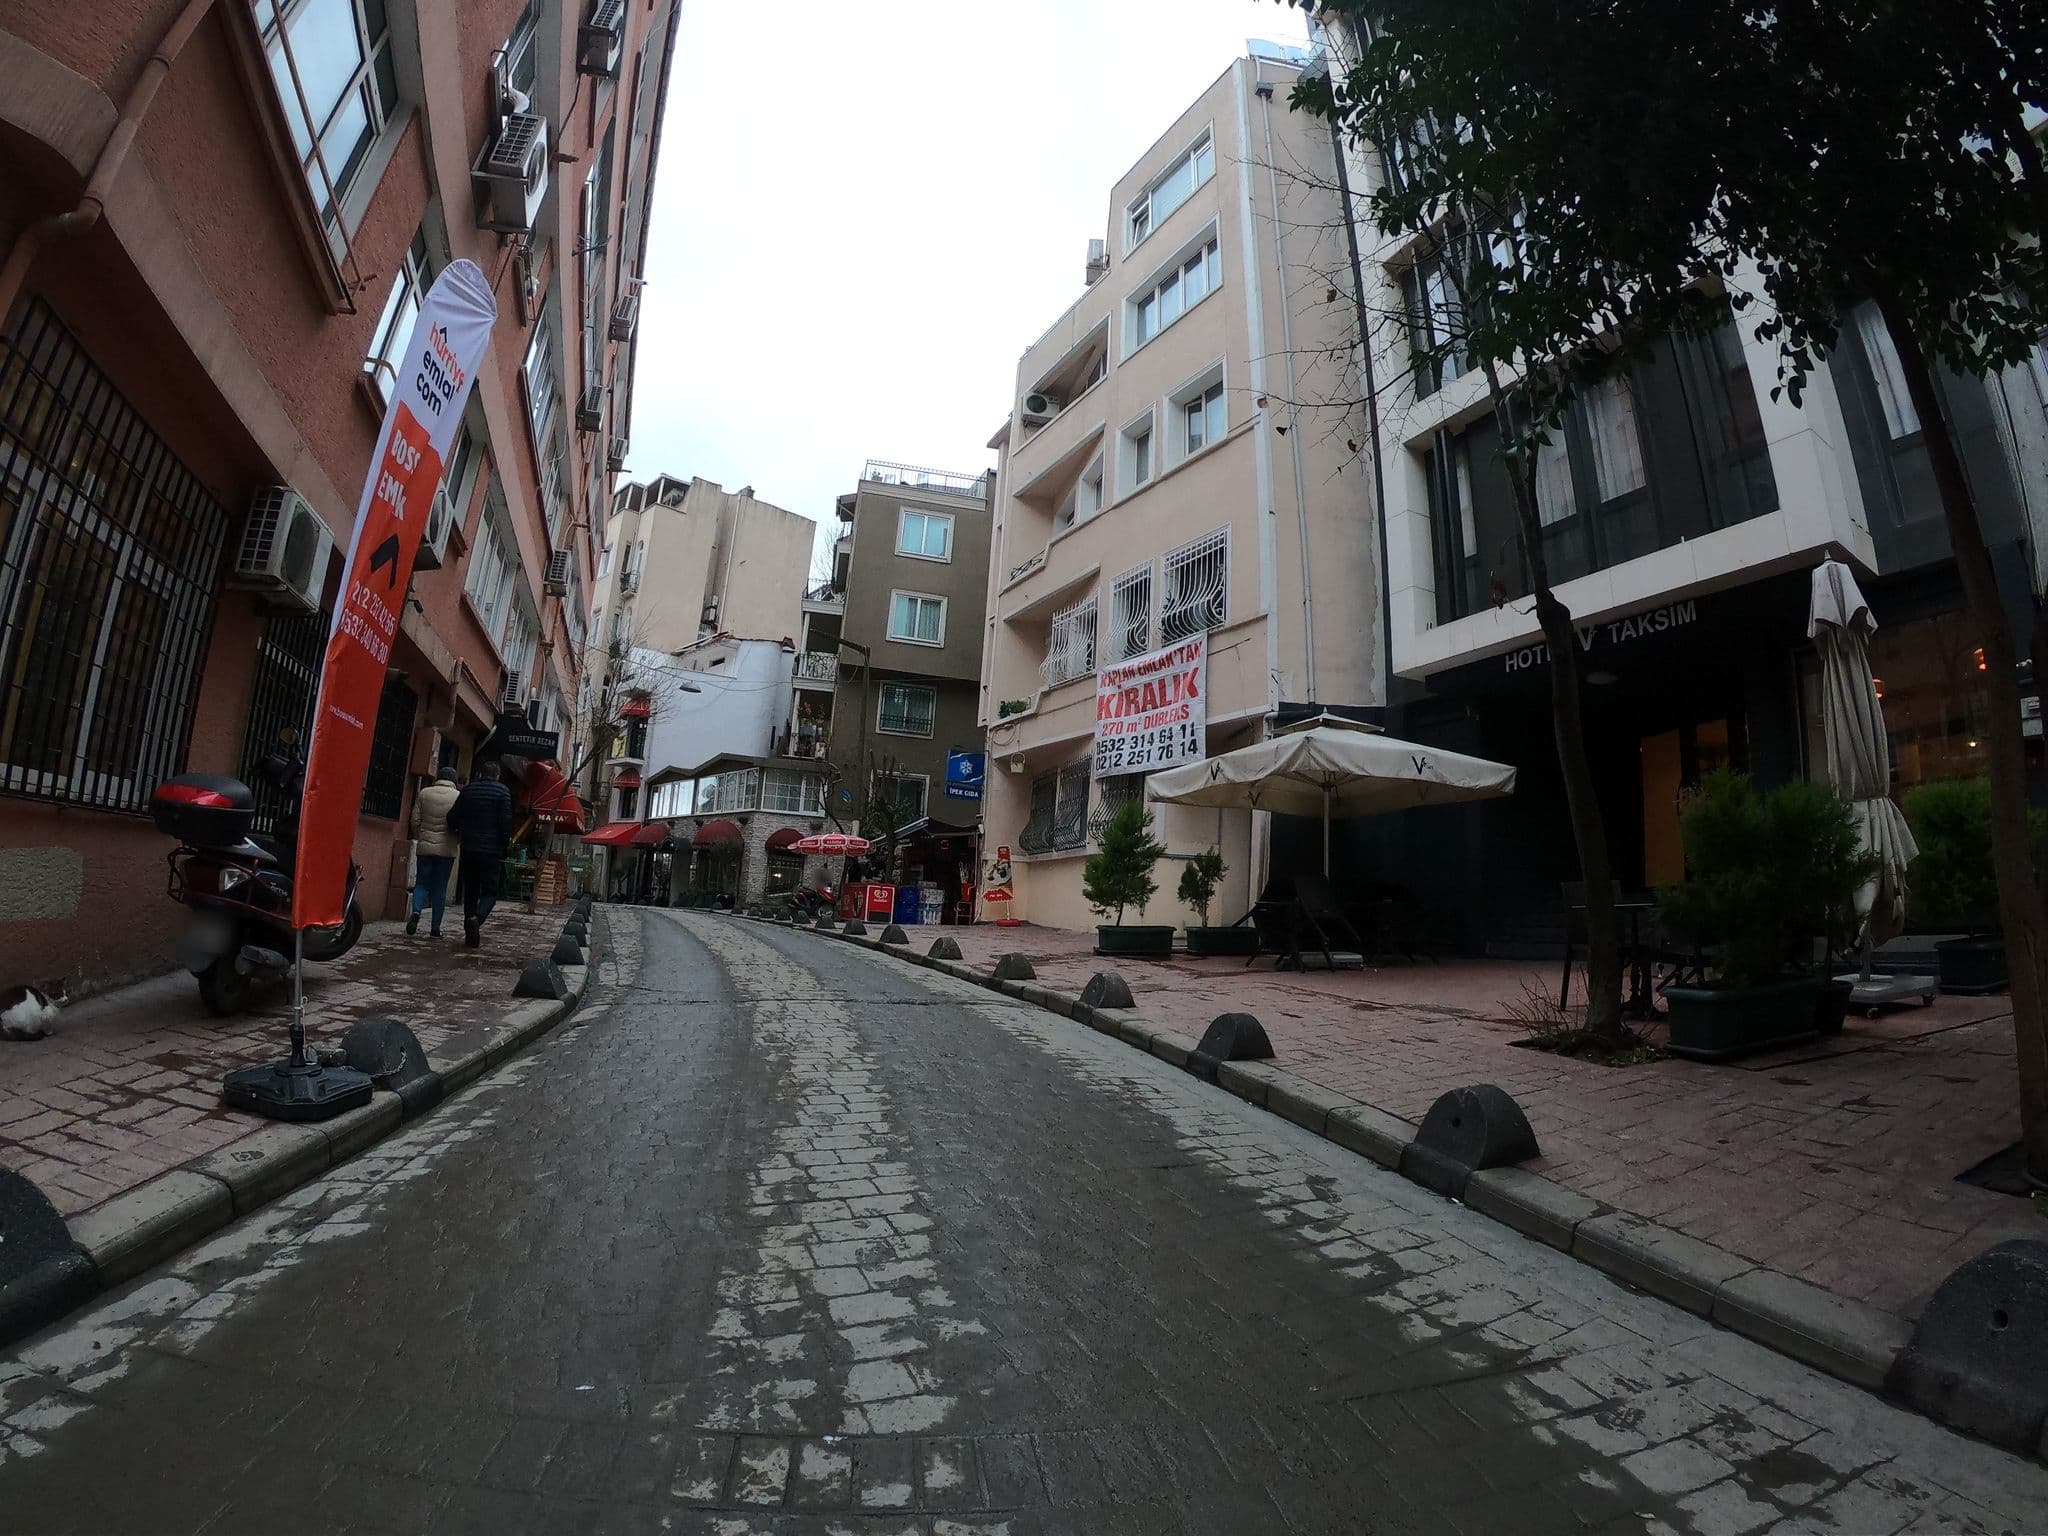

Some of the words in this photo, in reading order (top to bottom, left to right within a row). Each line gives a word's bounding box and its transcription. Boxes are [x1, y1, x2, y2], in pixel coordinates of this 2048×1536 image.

[416, 372, 442, 416] com
[1505, 644, 1551, 673] HOT
[1096, 738, 1126, 755] 0532
[1130, 731, 1154, 749] 314
[1160, 727, 1174, 744] 64
[1180, 722, 1195, 739] 11
[1102, 721, 1123, 737] 270
[1095, 752, 1123, 770] 0212
[1127, 749, 1152, 766] 251
[1158, 744, 1174, 760] 76
[1180, 739, 1198, 757] 14
